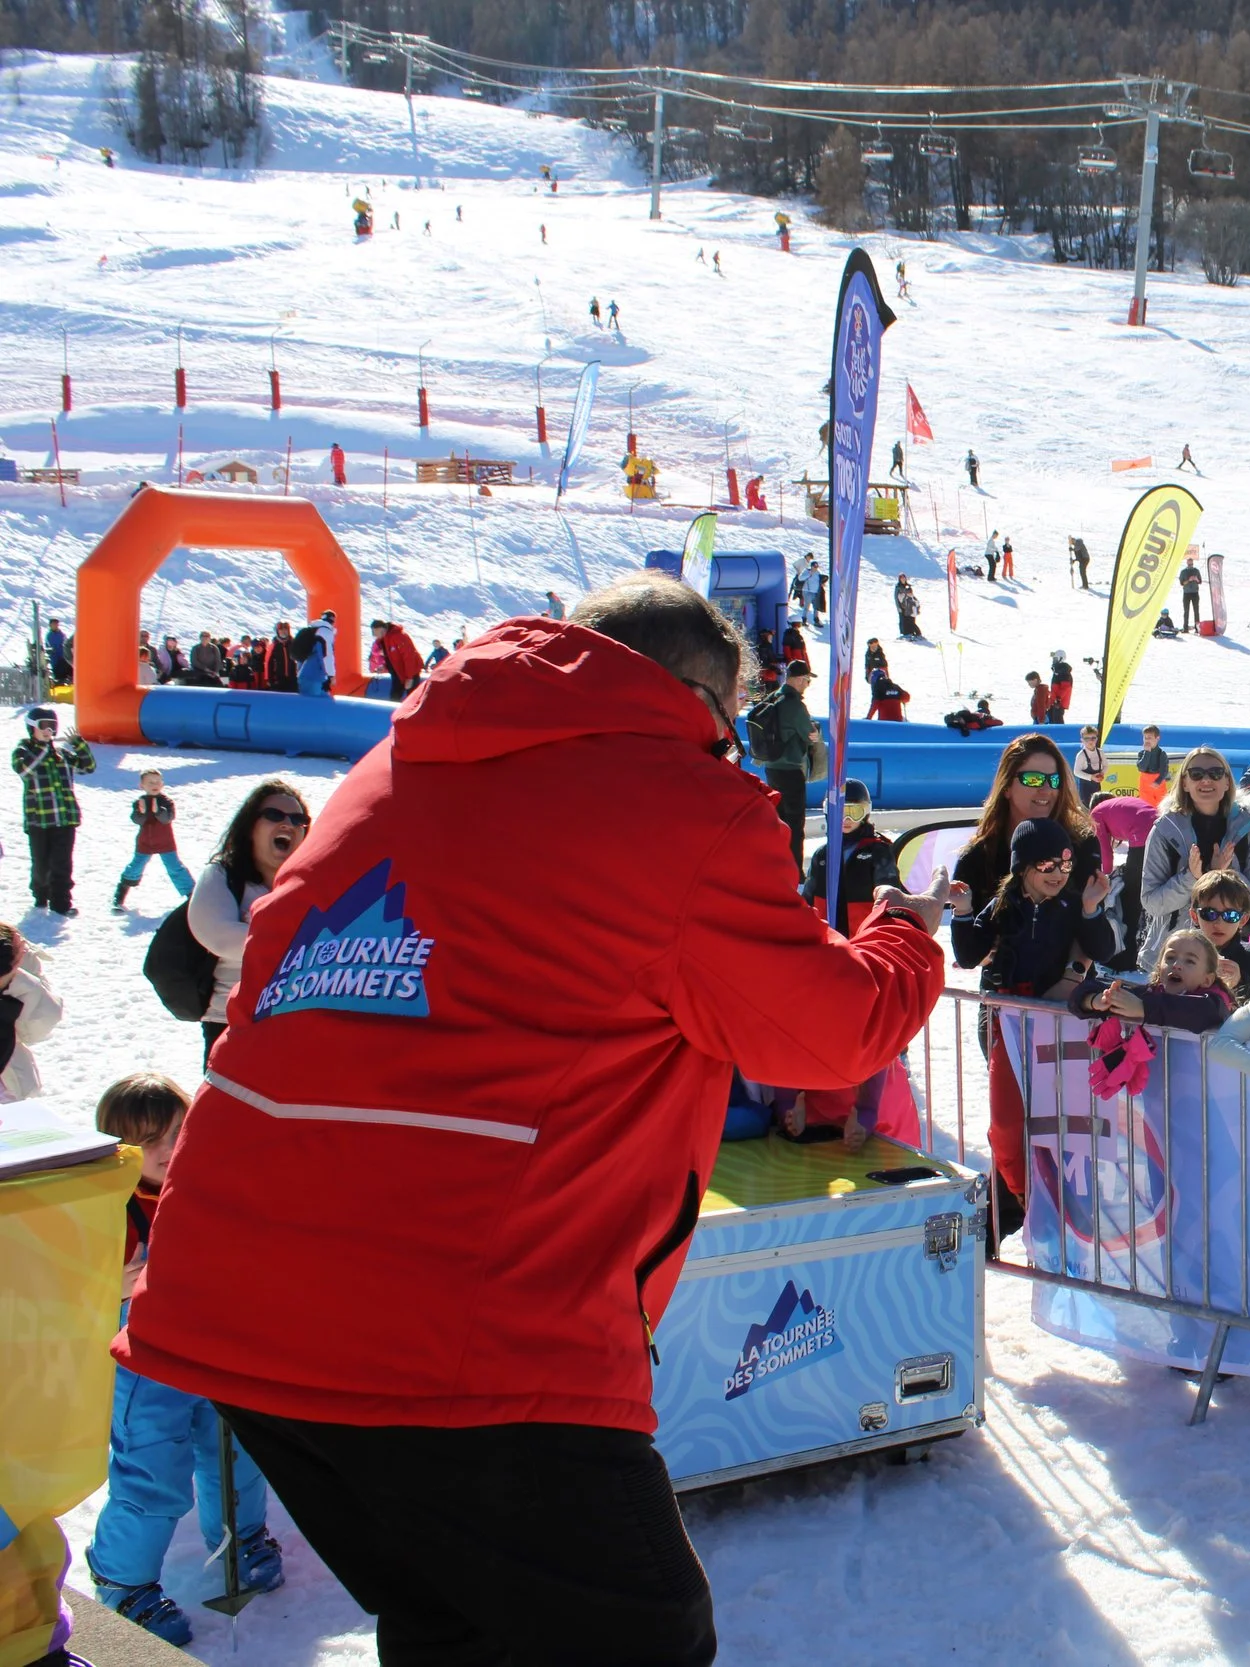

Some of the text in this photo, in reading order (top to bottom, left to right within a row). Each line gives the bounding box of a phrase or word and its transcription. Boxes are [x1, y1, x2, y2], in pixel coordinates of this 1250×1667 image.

[1130, 521, 1172, 595] OBUT
[1115, 789, 1135, 798] OBUT
[279, 931, 435, 974] LA TOURNÉE
[254, 968, 423, 1015] DES SOMMETS
[723, 1328, 835, 1395] DES SOMMETS
[739, 1309, 836, 1369] LA TOURNÉE
